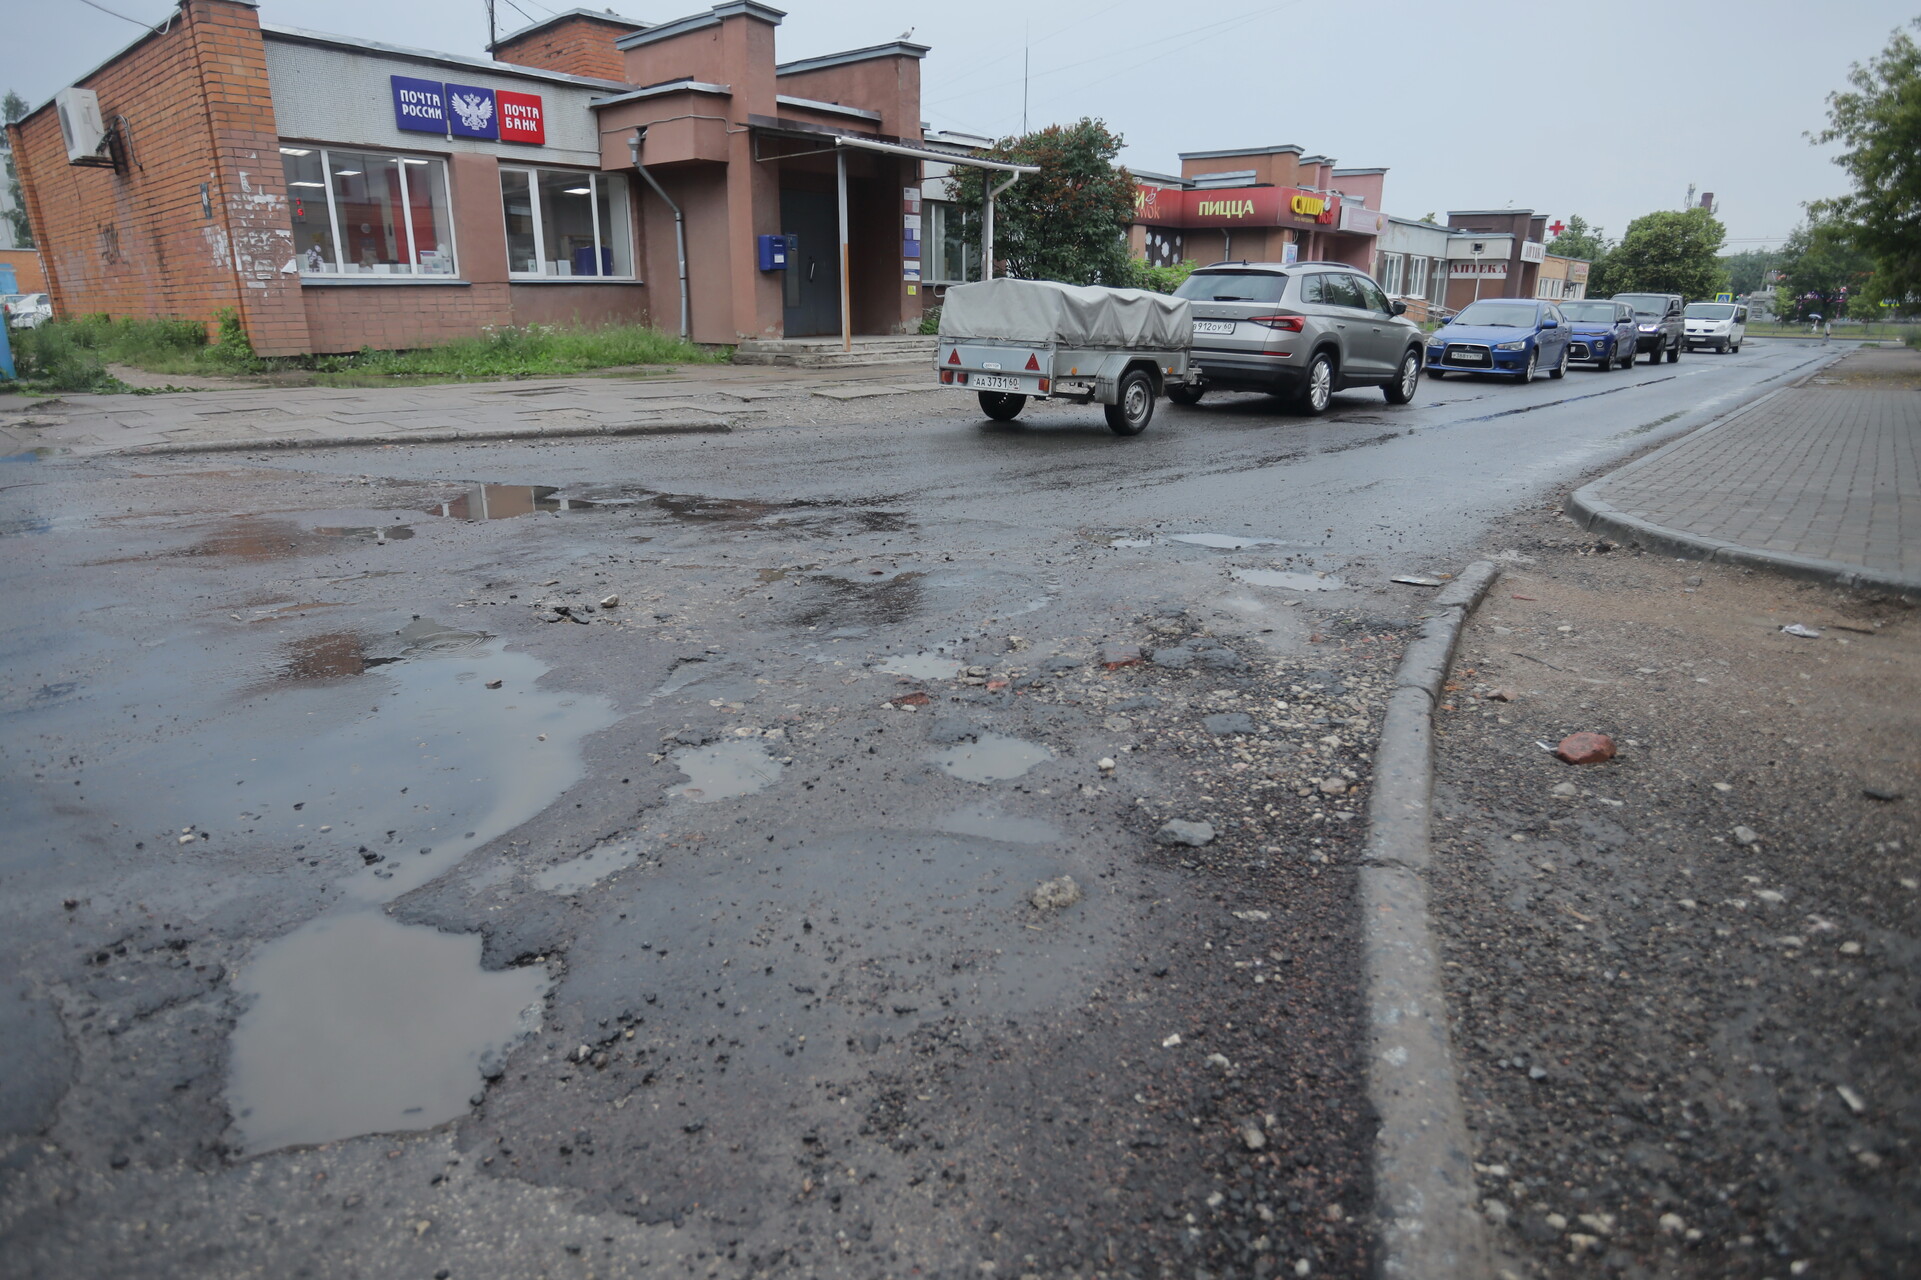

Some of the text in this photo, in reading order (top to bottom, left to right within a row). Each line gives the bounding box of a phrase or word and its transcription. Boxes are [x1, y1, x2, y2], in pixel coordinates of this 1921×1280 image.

[400, 90, 440, 106] ПОЧТА
[402, 104, 442, 119] РОССИИ
[504, 104, 539, 119] ПОЧТА
[506, 117, 537, 131] БАНК
[1198, 200, 1254, 219] ПИЦЦА
[1450, 264, 1507, 273] АПТЕКА
